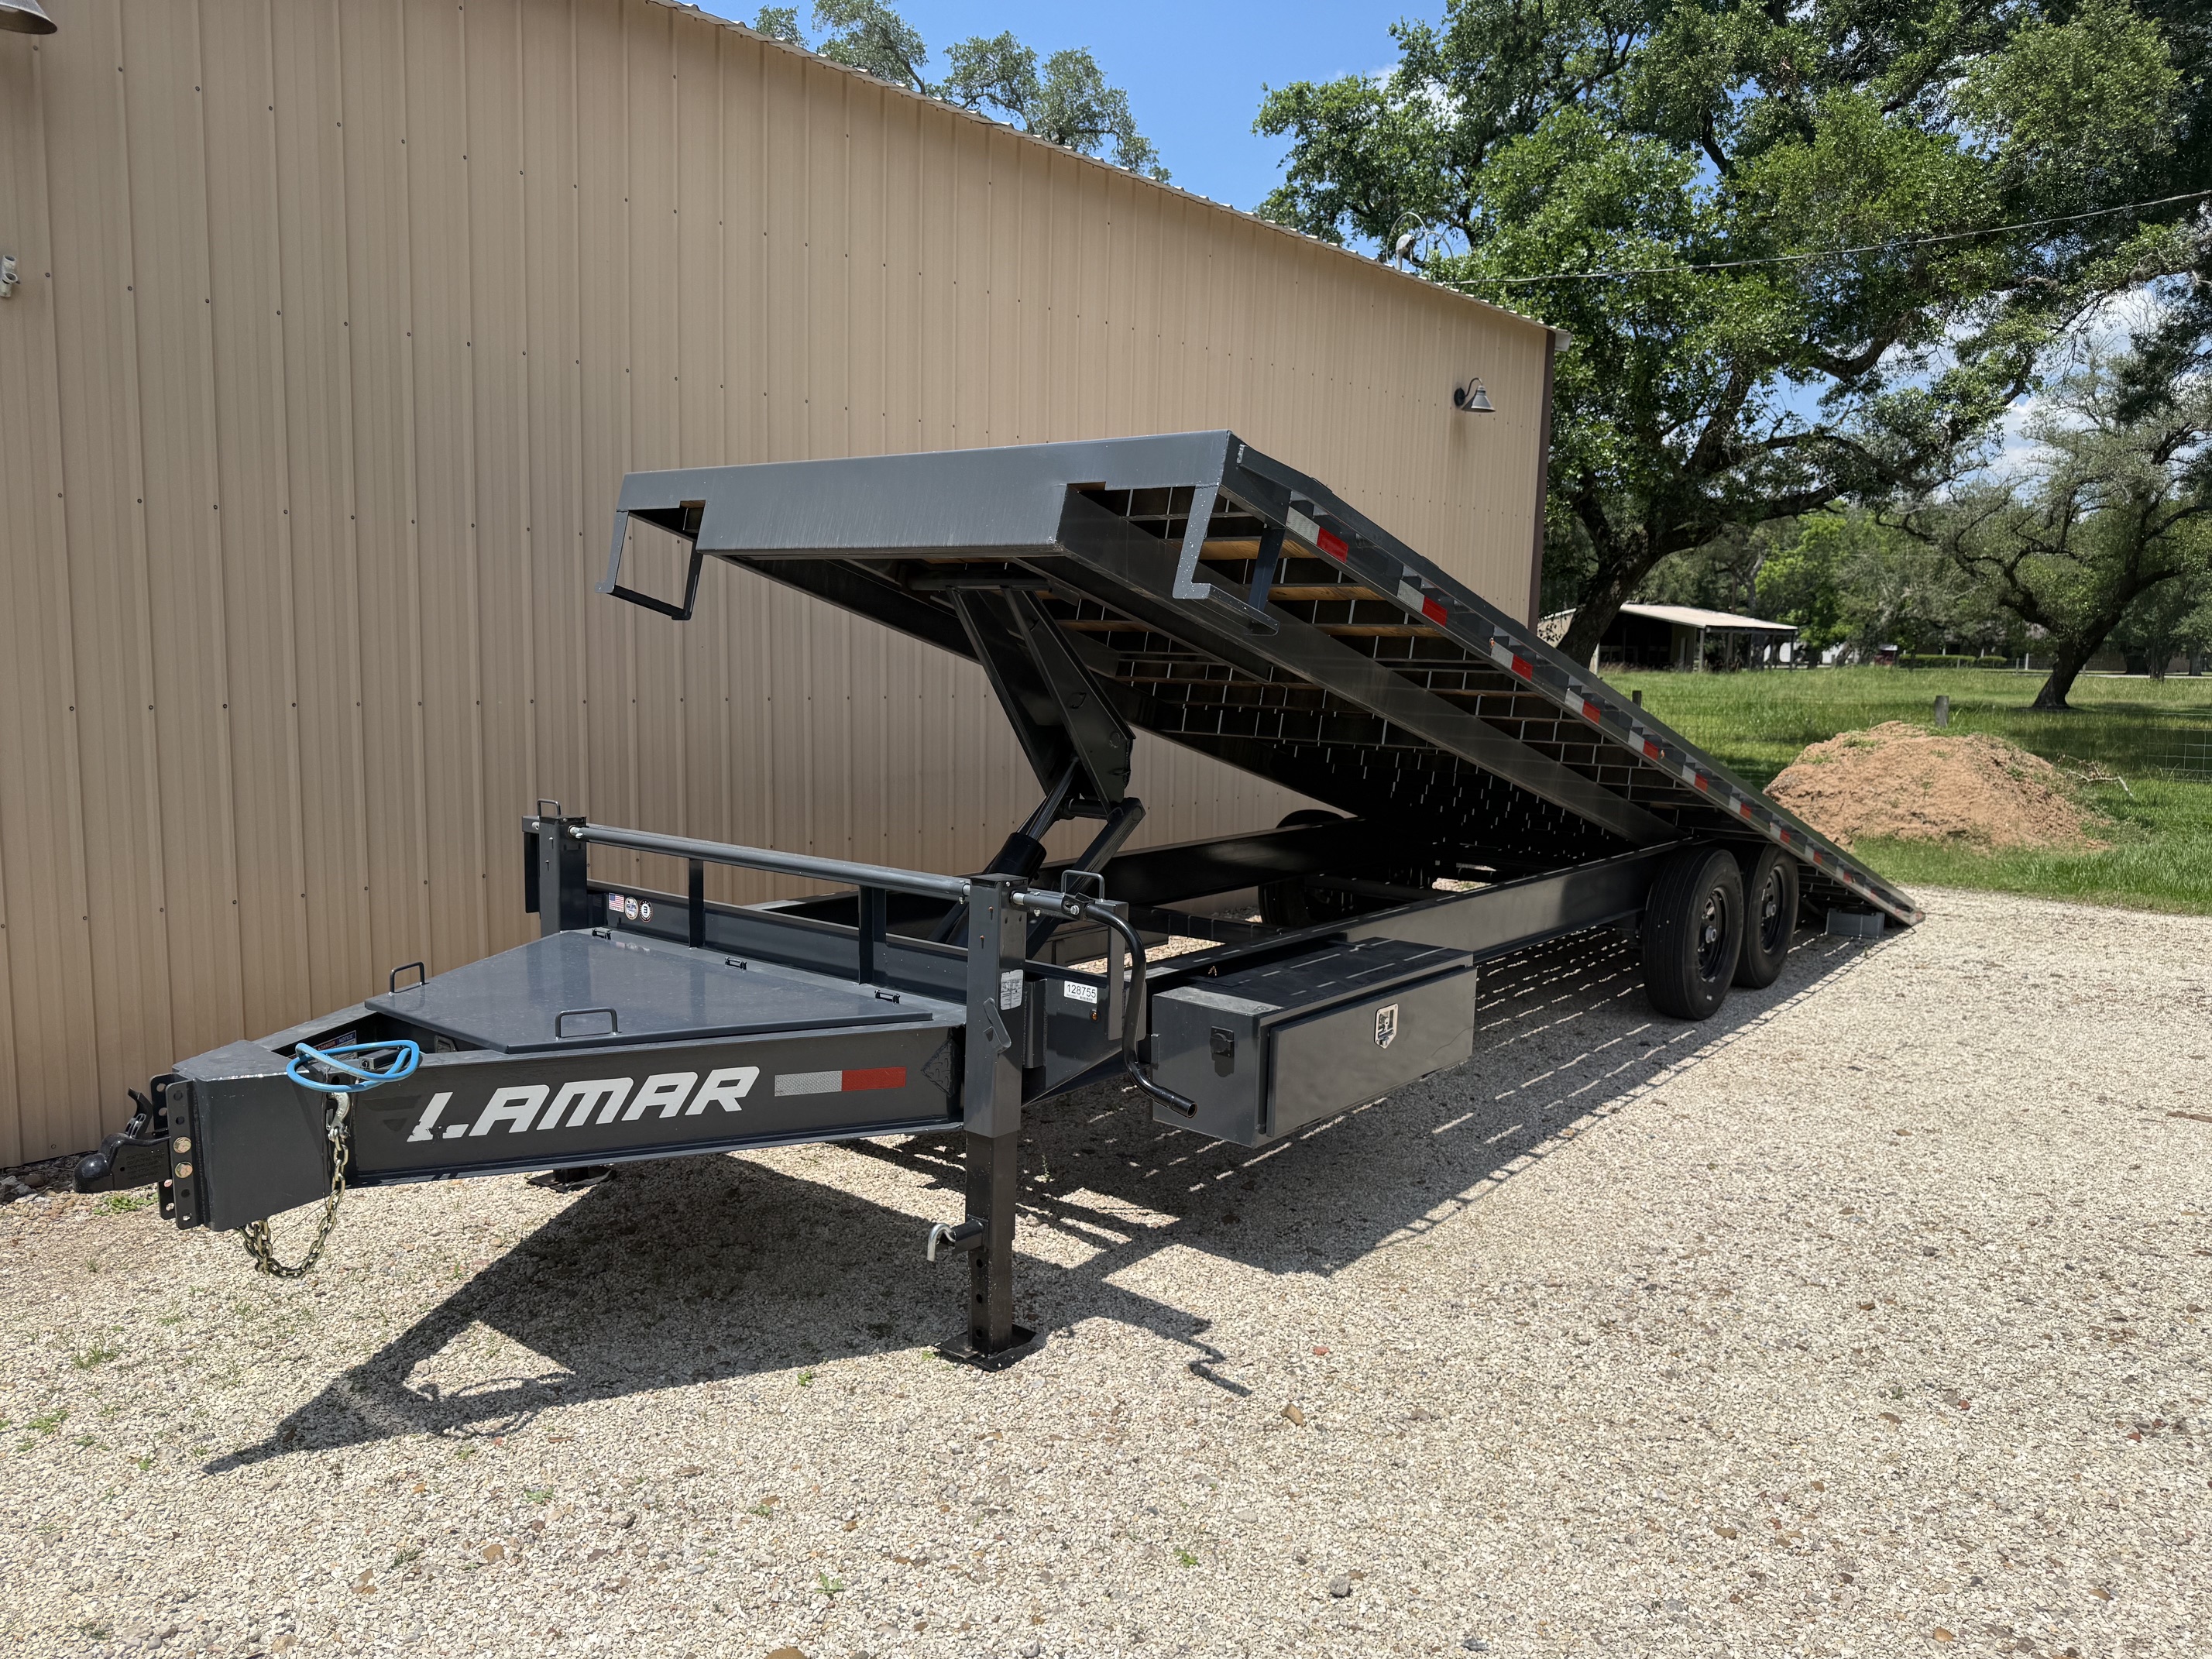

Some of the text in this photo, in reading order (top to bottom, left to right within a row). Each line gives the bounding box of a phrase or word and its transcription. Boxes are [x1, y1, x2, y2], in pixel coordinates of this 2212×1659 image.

[1067, 984, 1097, 998] 128755
[338, 1033, 354, 1043] NOTICE
[320, 1040, 336, 1050] DANGER
[407, 1066, 761, 1142] LAMAR
